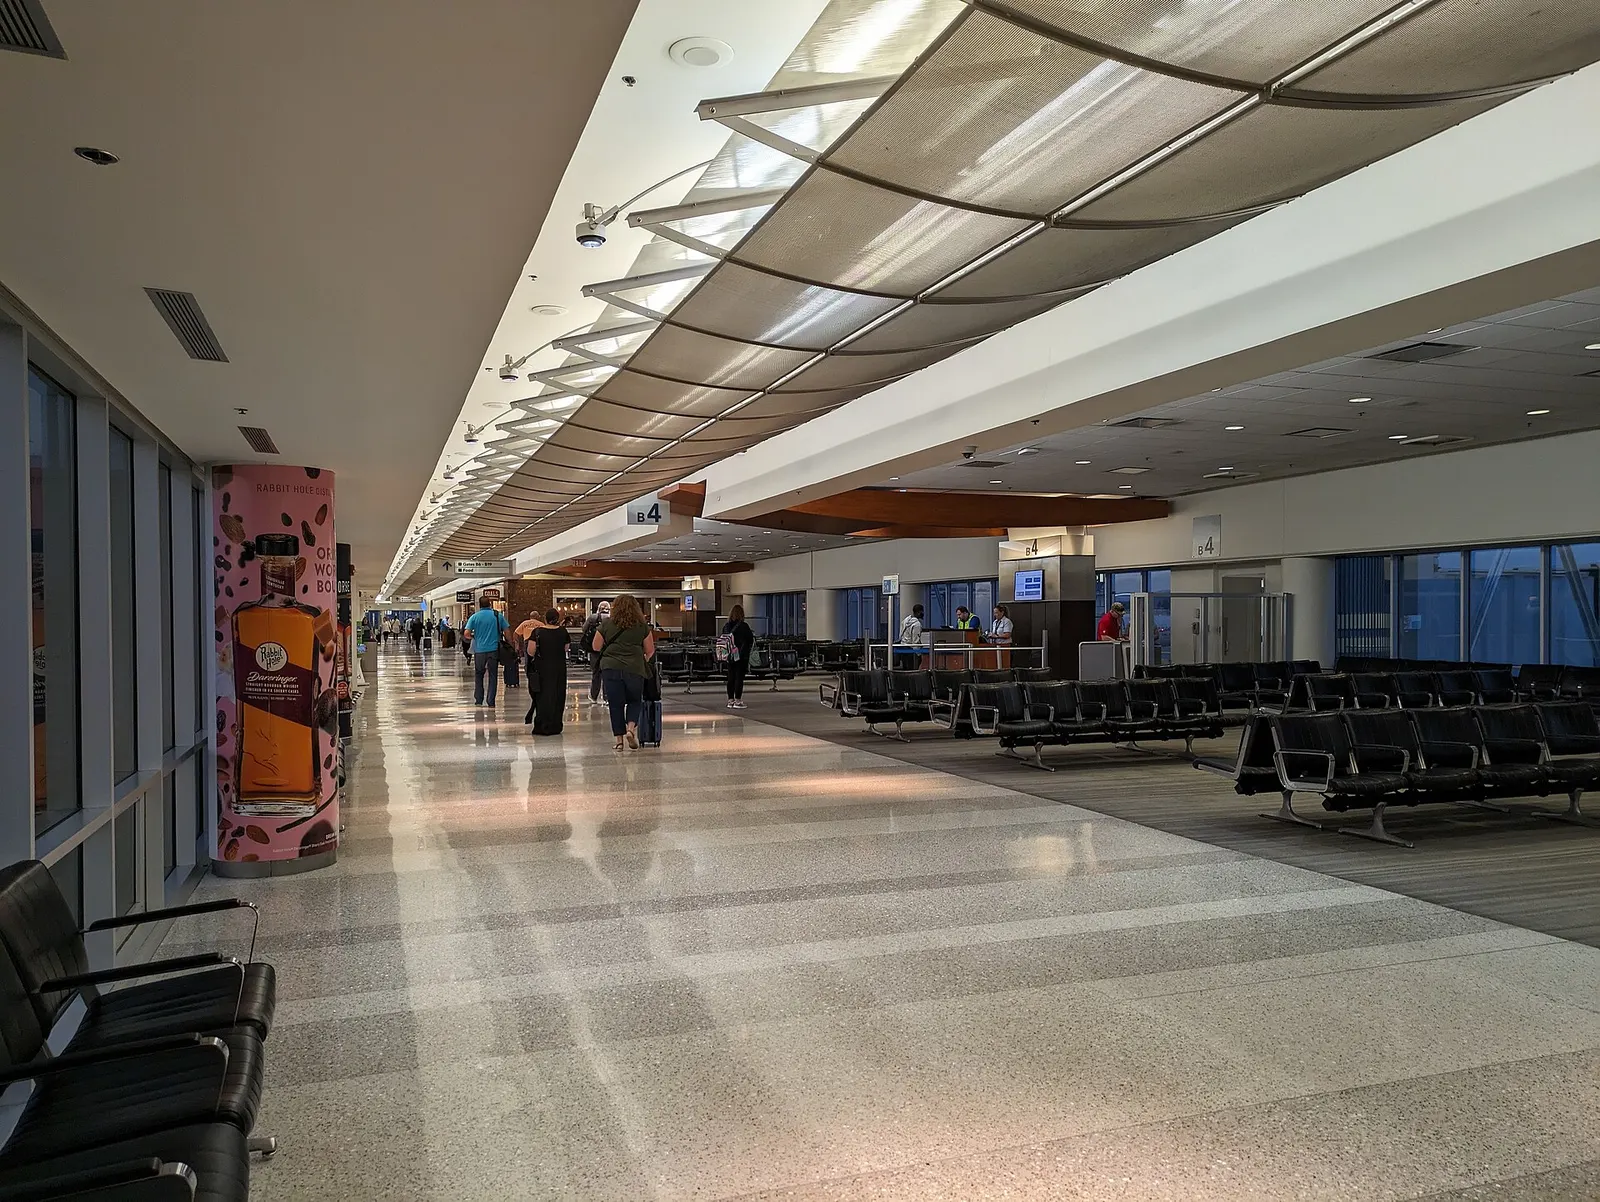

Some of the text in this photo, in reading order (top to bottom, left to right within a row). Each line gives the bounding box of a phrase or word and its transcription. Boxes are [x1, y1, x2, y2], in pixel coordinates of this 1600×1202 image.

[256, 484, 291, 493] RABBIT
[293, 485, 314, 495] HOLE
[260, 646, 283, 663] Rabbit
[266, 656, 282, 670] Hole
